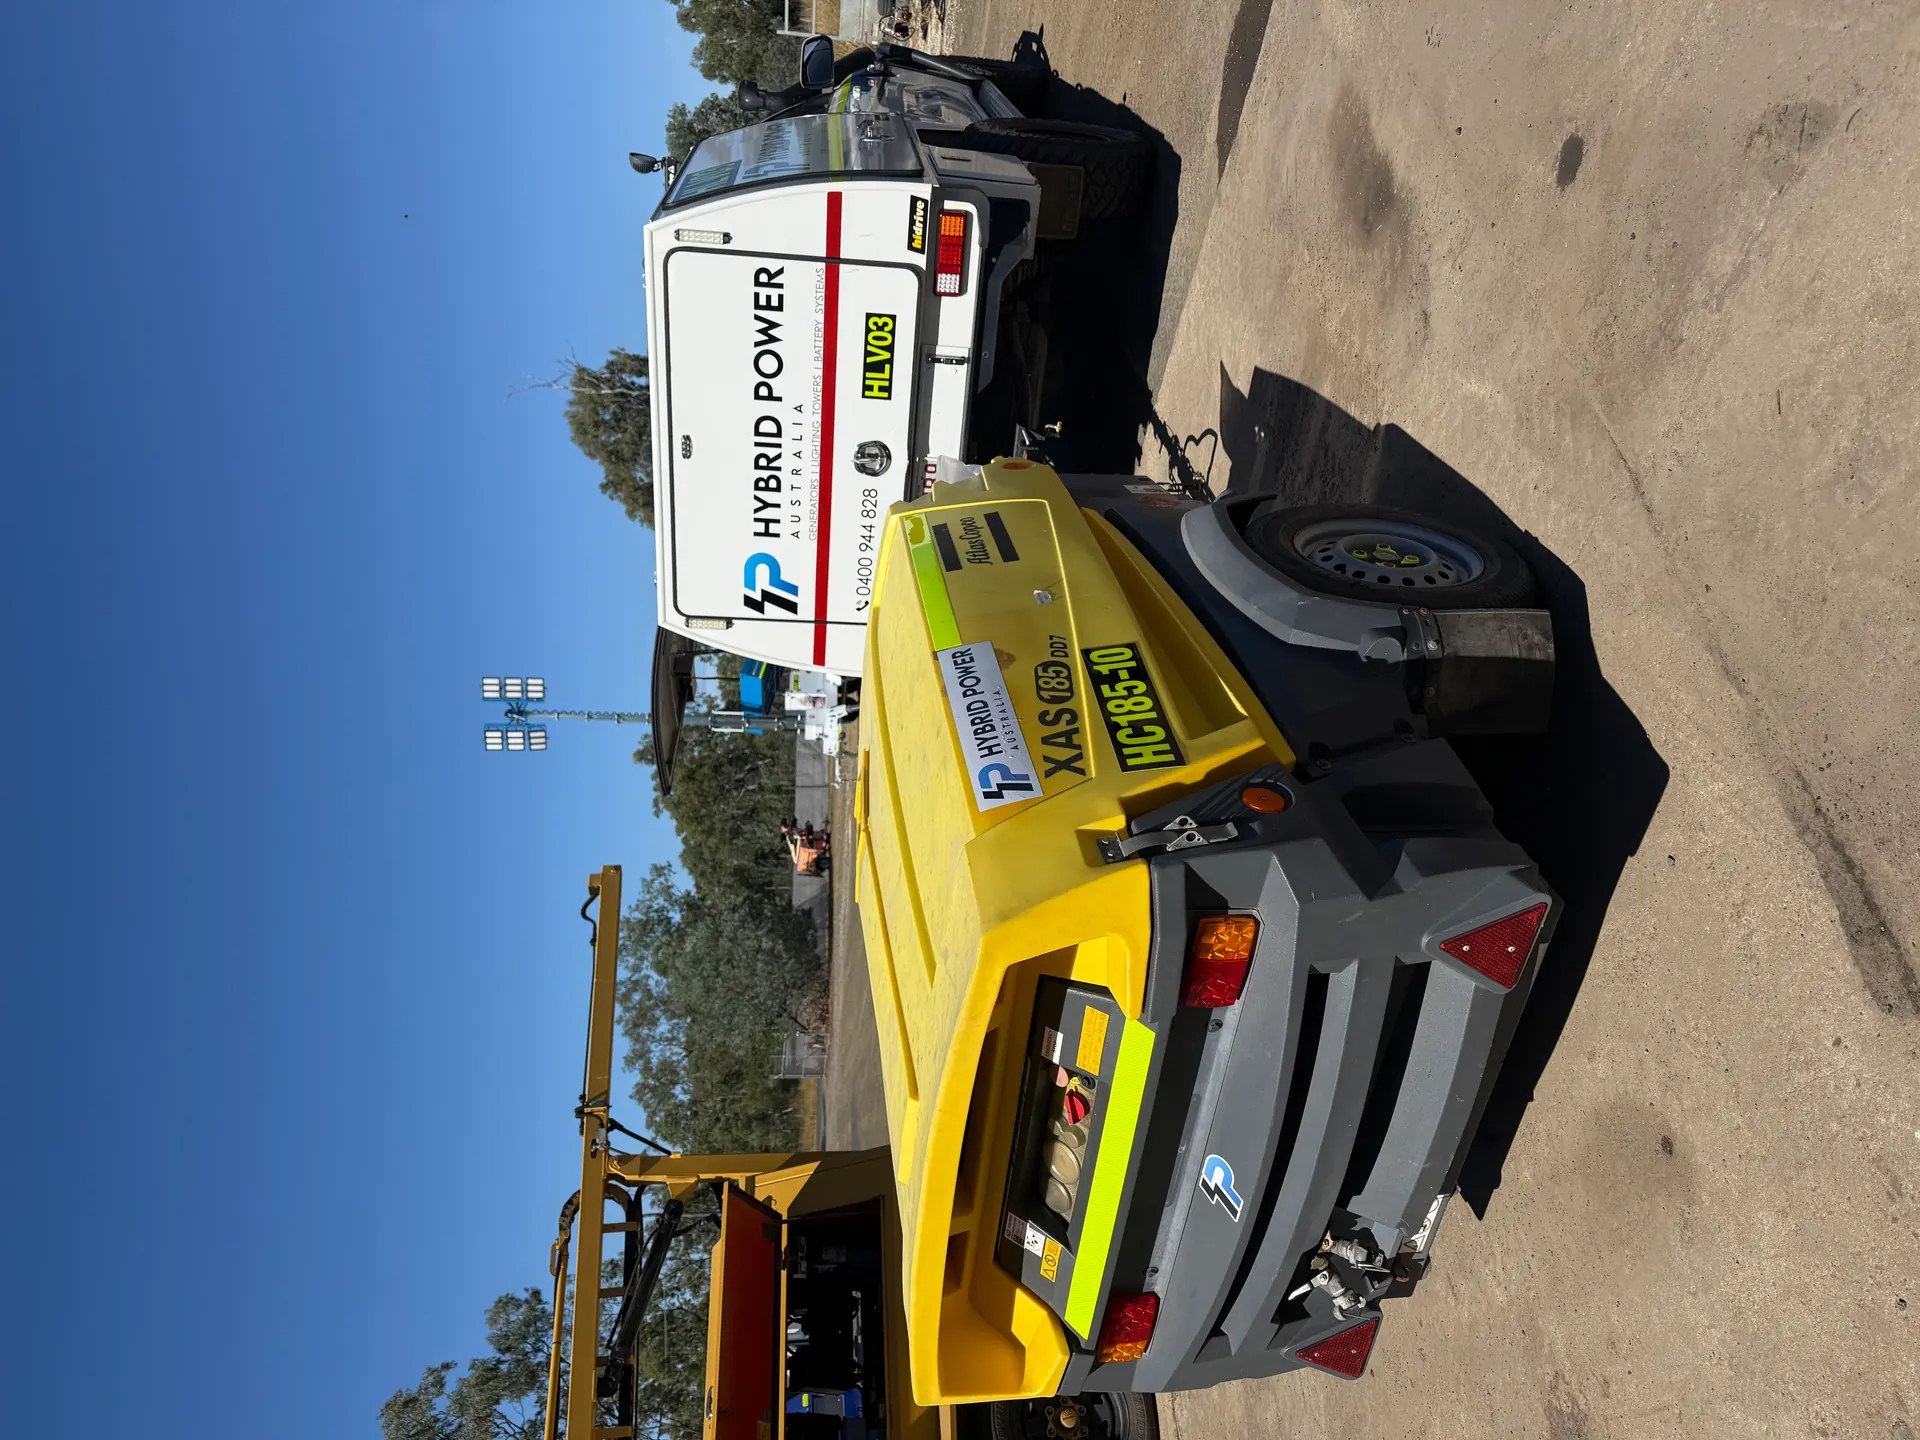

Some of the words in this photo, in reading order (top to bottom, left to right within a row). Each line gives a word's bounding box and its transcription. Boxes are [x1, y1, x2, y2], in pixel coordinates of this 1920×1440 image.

[911, 200, 925, 249] hidrive
[814, 267, 825, 314] SYSTEMS
[753, 266, 785, 402] POWER
[813, 320, 824, 362] BATTERY
[864, 316, 894, 398] HLV03
[812, 375, 823, 415] TOWERS
[810, 420, 821, 467] LIGHTING
[753, 415, 783, 538] HYBRID
[790, 404, 803, 539] AUSTRALIA
[808, 478, 819, 541] GENERATORS
[861, 488, 878, 519] 828
[858, 524, 876, 552] 944
[856, 557, 873, 596] 0400
[1049, 635, 1069, 659] DD7
[952, 647, 985, 699] POWER
[1037, 663, 1071, 700] 185
[966, 699, 1003, 759] HYBRID
[993, 689, 1020, 751] AUSTRALIA
[1089, 646, 1176, 767] HC185-10
[1038, 707, 1087, 779] XAS
